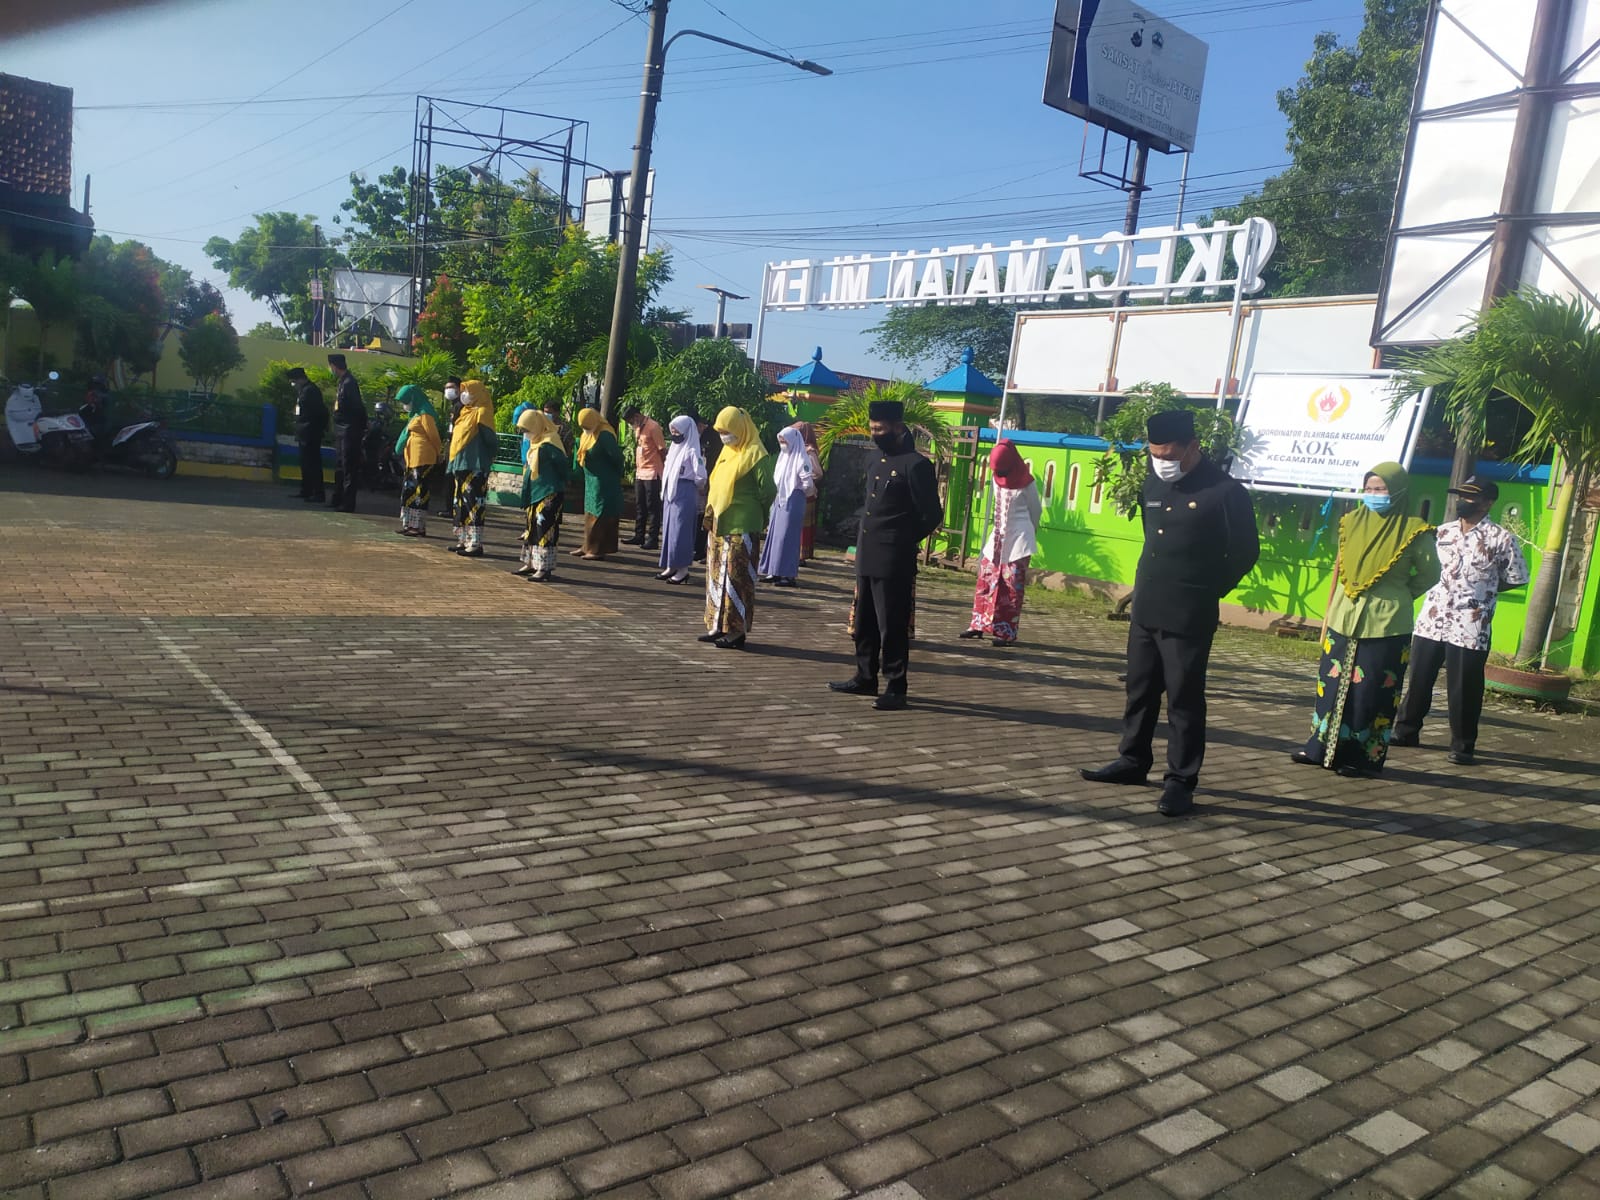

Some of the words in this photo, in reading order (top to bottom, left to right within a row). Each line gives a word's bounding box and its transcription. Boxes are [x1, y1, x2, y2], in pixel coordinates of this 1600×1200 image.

[1101, 45, 1139, 74] SAMSAT
[1126, 79, 1171, 118] PATEN
[1303, 430, 1340, 440] OLAHRAGA
[1341, 431, 1385, 441] KECAMATAN
[1290, 439, 1338, 456] KOK
[1266, 453, 1326, 466] KECAMATAN
[1327, 457, 1360, 467] MIJEN
